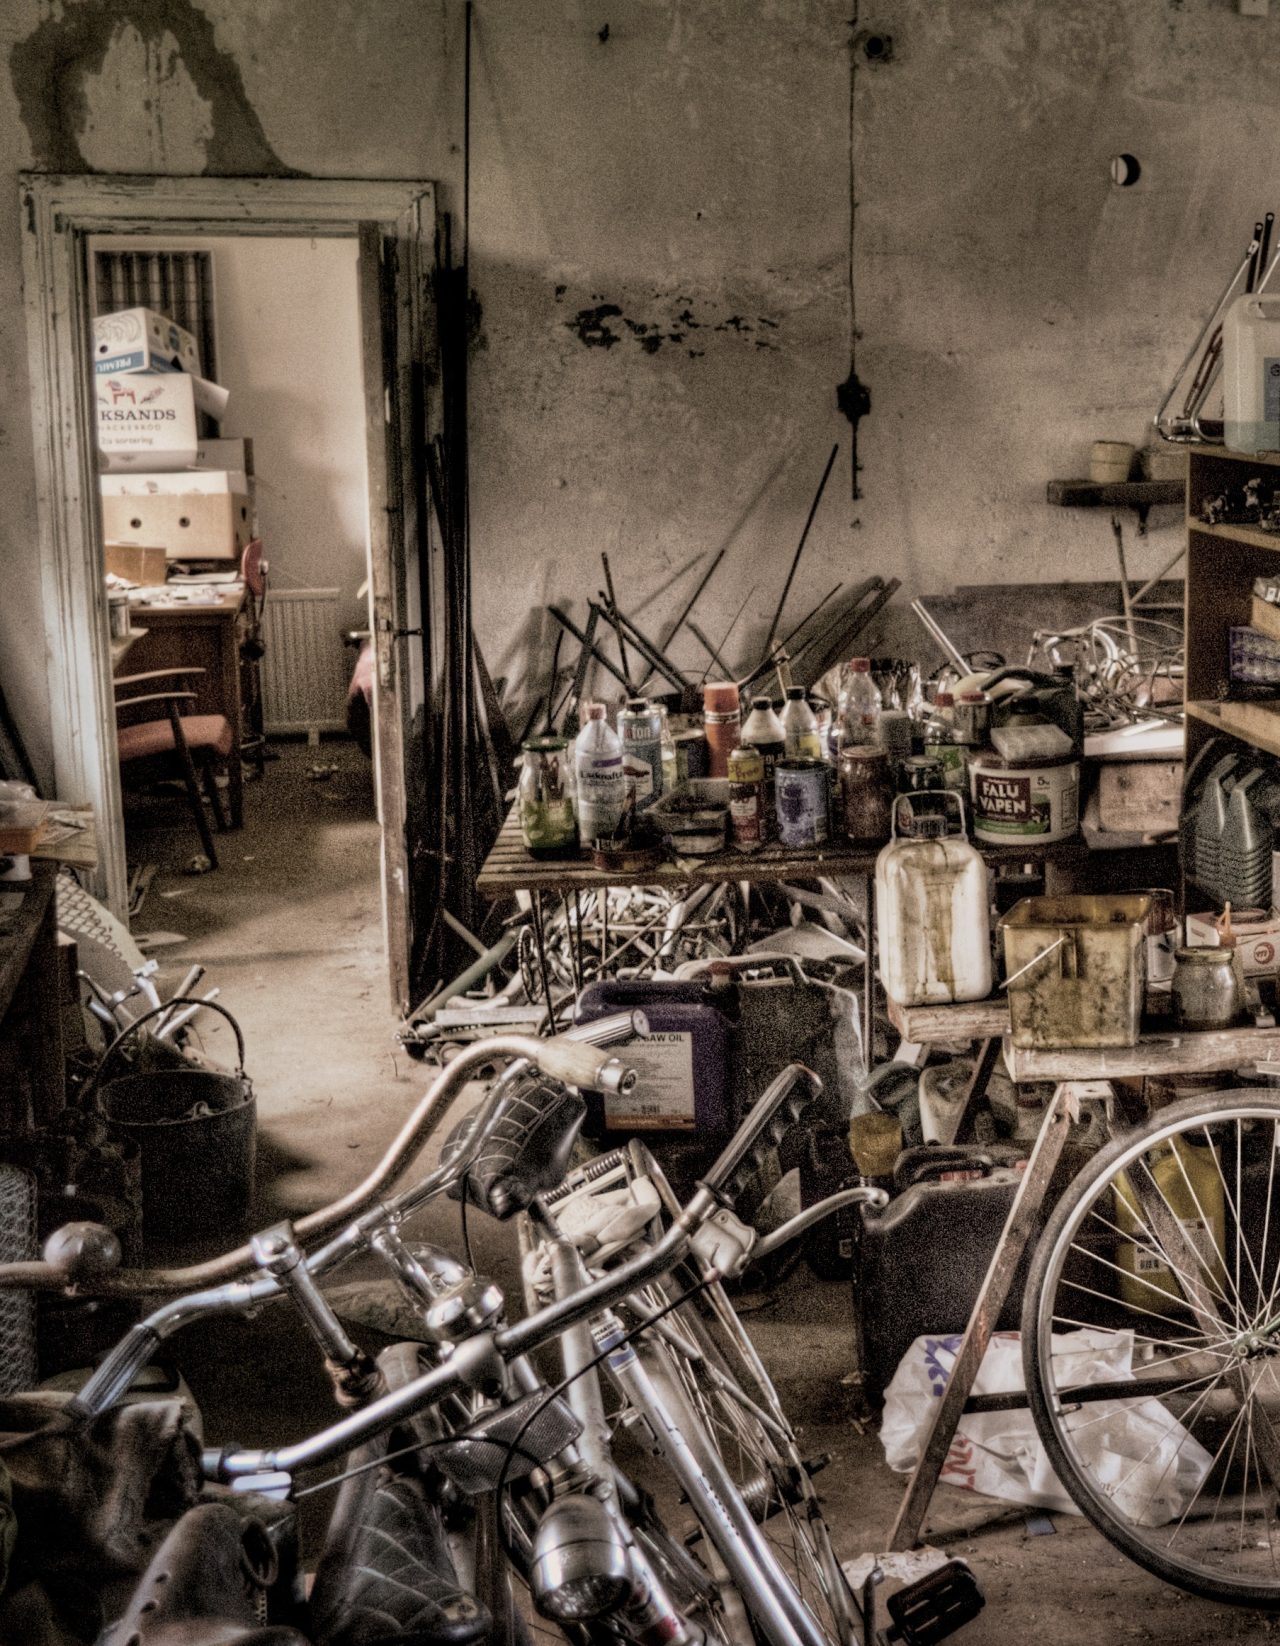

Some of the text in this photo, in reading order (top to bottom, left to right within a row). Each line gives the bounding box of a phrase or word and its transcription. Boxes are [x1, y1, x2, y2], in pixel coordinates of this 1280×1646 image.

[95, 356, 132, 373] PREMIU
[100, 409, 177, 421] KSANDS
[982, 781, 1020, 798] FALU
[980, 795, 1026, 814] VAPEN
[669, 1034, 685, 1042] OIL
